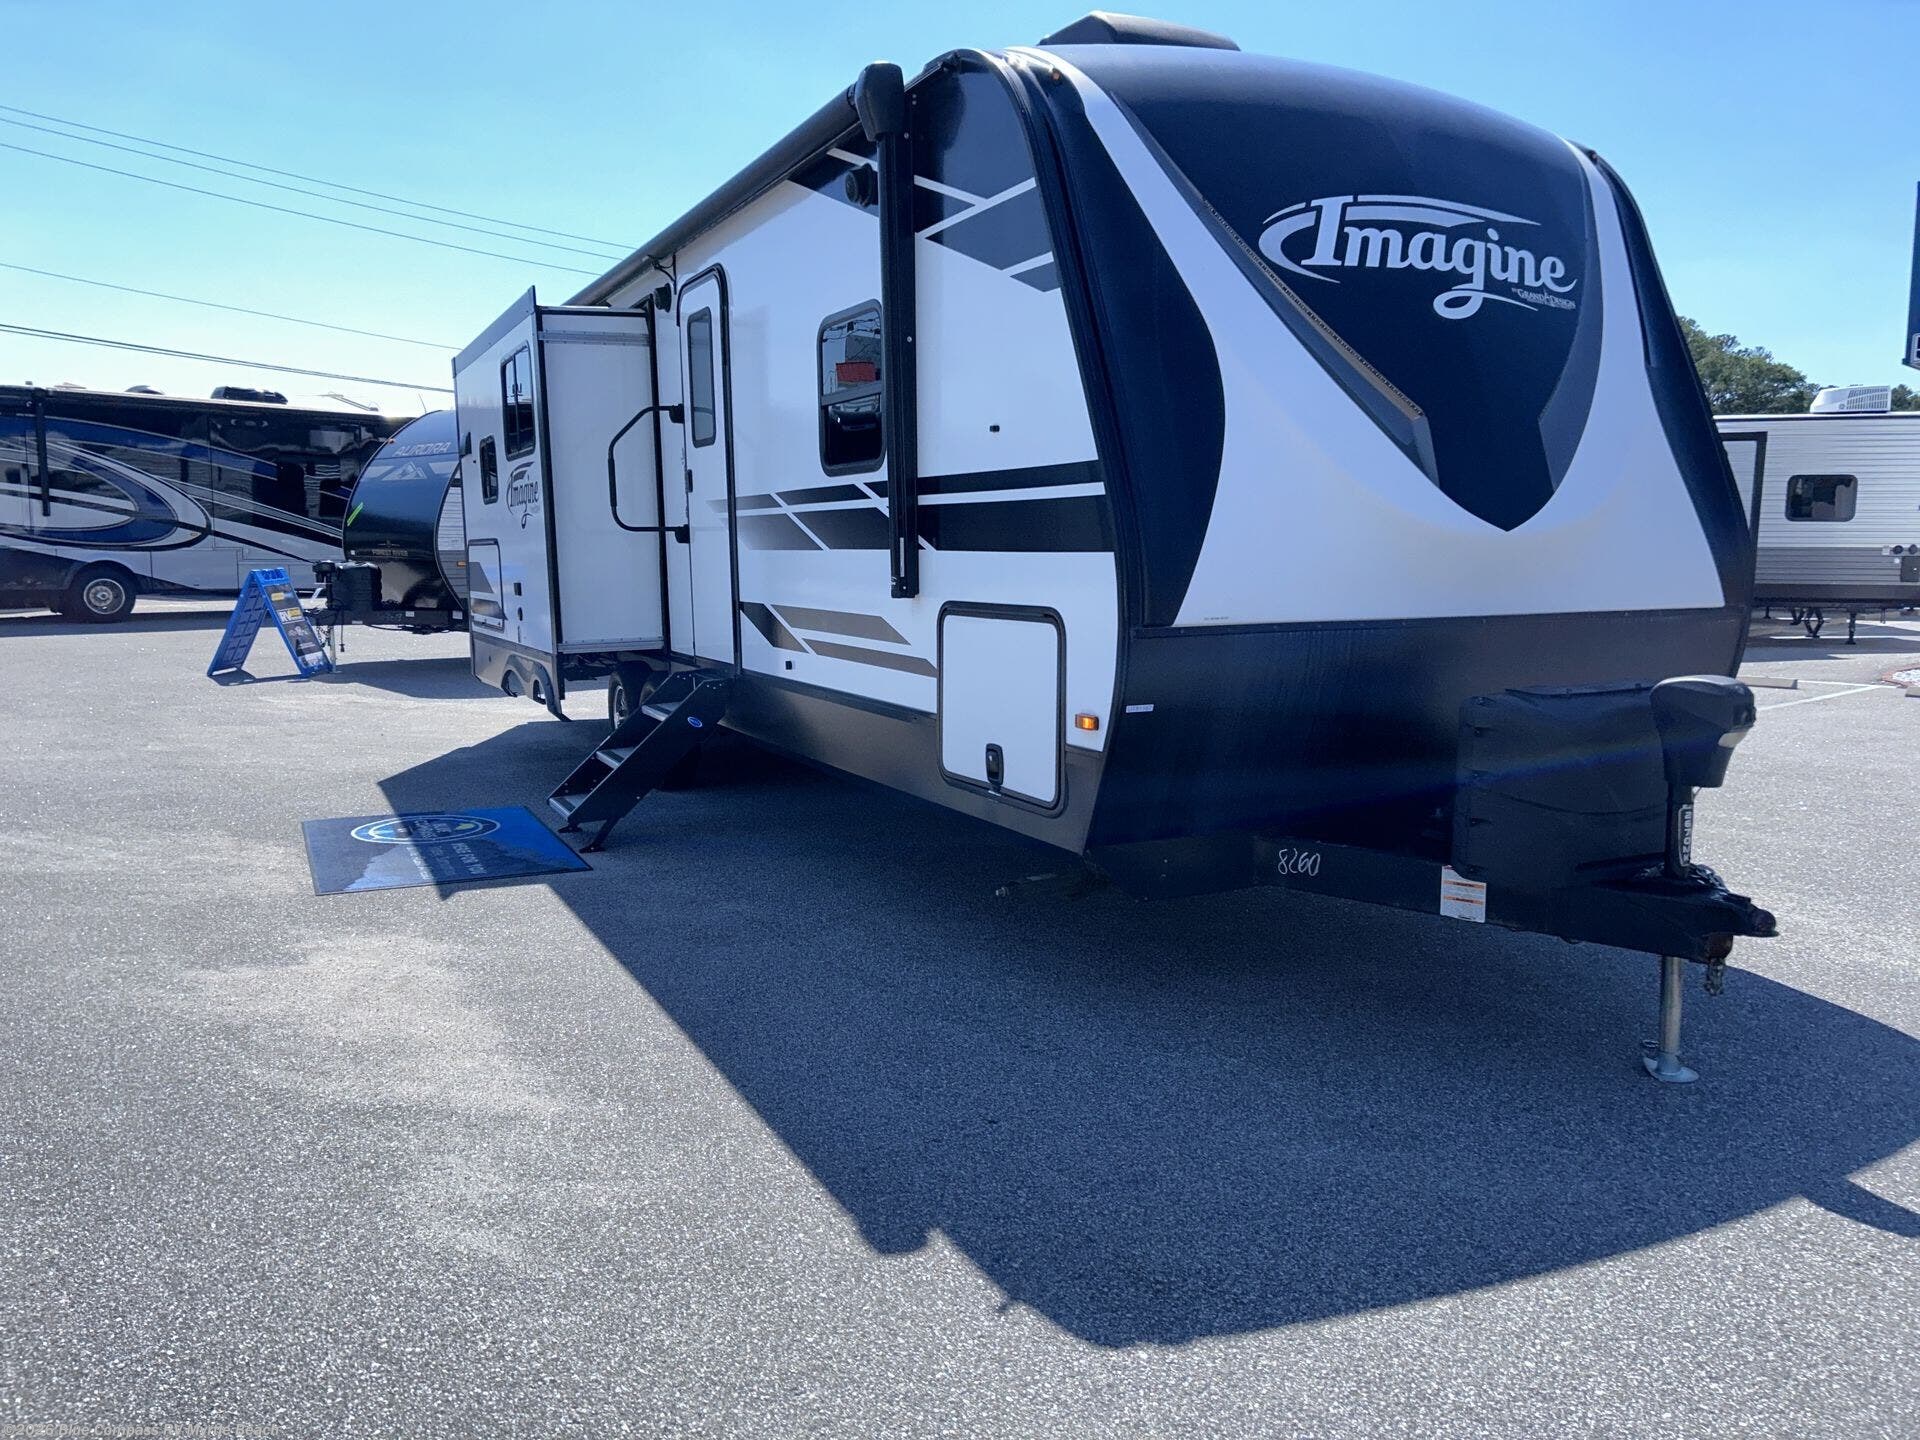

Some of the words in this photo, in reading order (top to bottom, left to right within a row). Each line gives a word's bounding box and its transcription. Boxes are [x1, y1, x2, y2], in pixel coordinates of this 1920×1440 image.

[1299, 199, 1579, 320] Imagine
[392, 442, 451, 457] AURORA
[508, 468, 539, 530] Imagine
[1277, 847, 1321, 877] 8260
